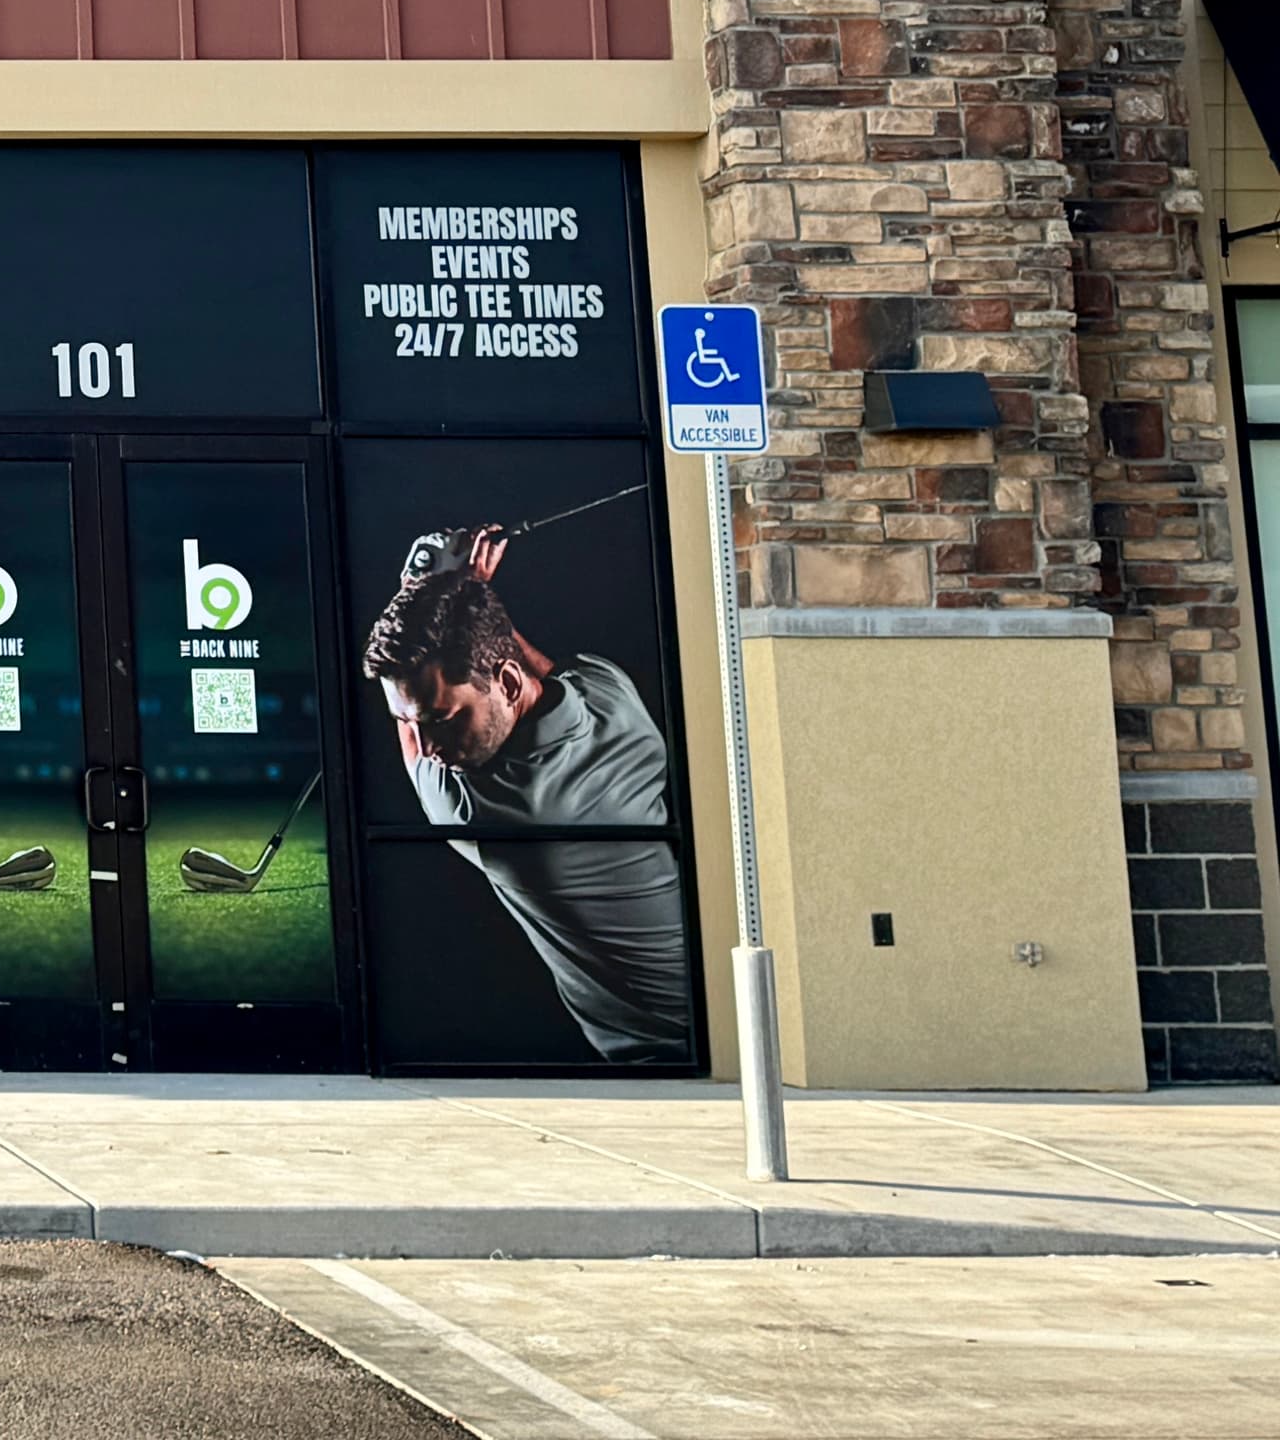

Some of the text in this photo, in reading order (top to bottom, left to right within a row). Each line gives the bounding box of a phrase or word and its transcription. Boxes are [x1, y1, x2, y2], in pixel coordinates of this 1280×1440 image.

[378, 207, 579, 241] MEMBERSHIPS
[431, 245, 530, 279] EVENTS
[363, 284, 605, 319] PUBLIC TEE TIMES
[394, 323, 579, 358] 24/7 ACCESS
[52, 342, 136, 398] 101
[705, 409, 729, 423] VAN
[680, 428, 758, 442] ACCESSIBLE
[192, 639, 226, 658] BACK
[229, 640, 260, 658] NINE
